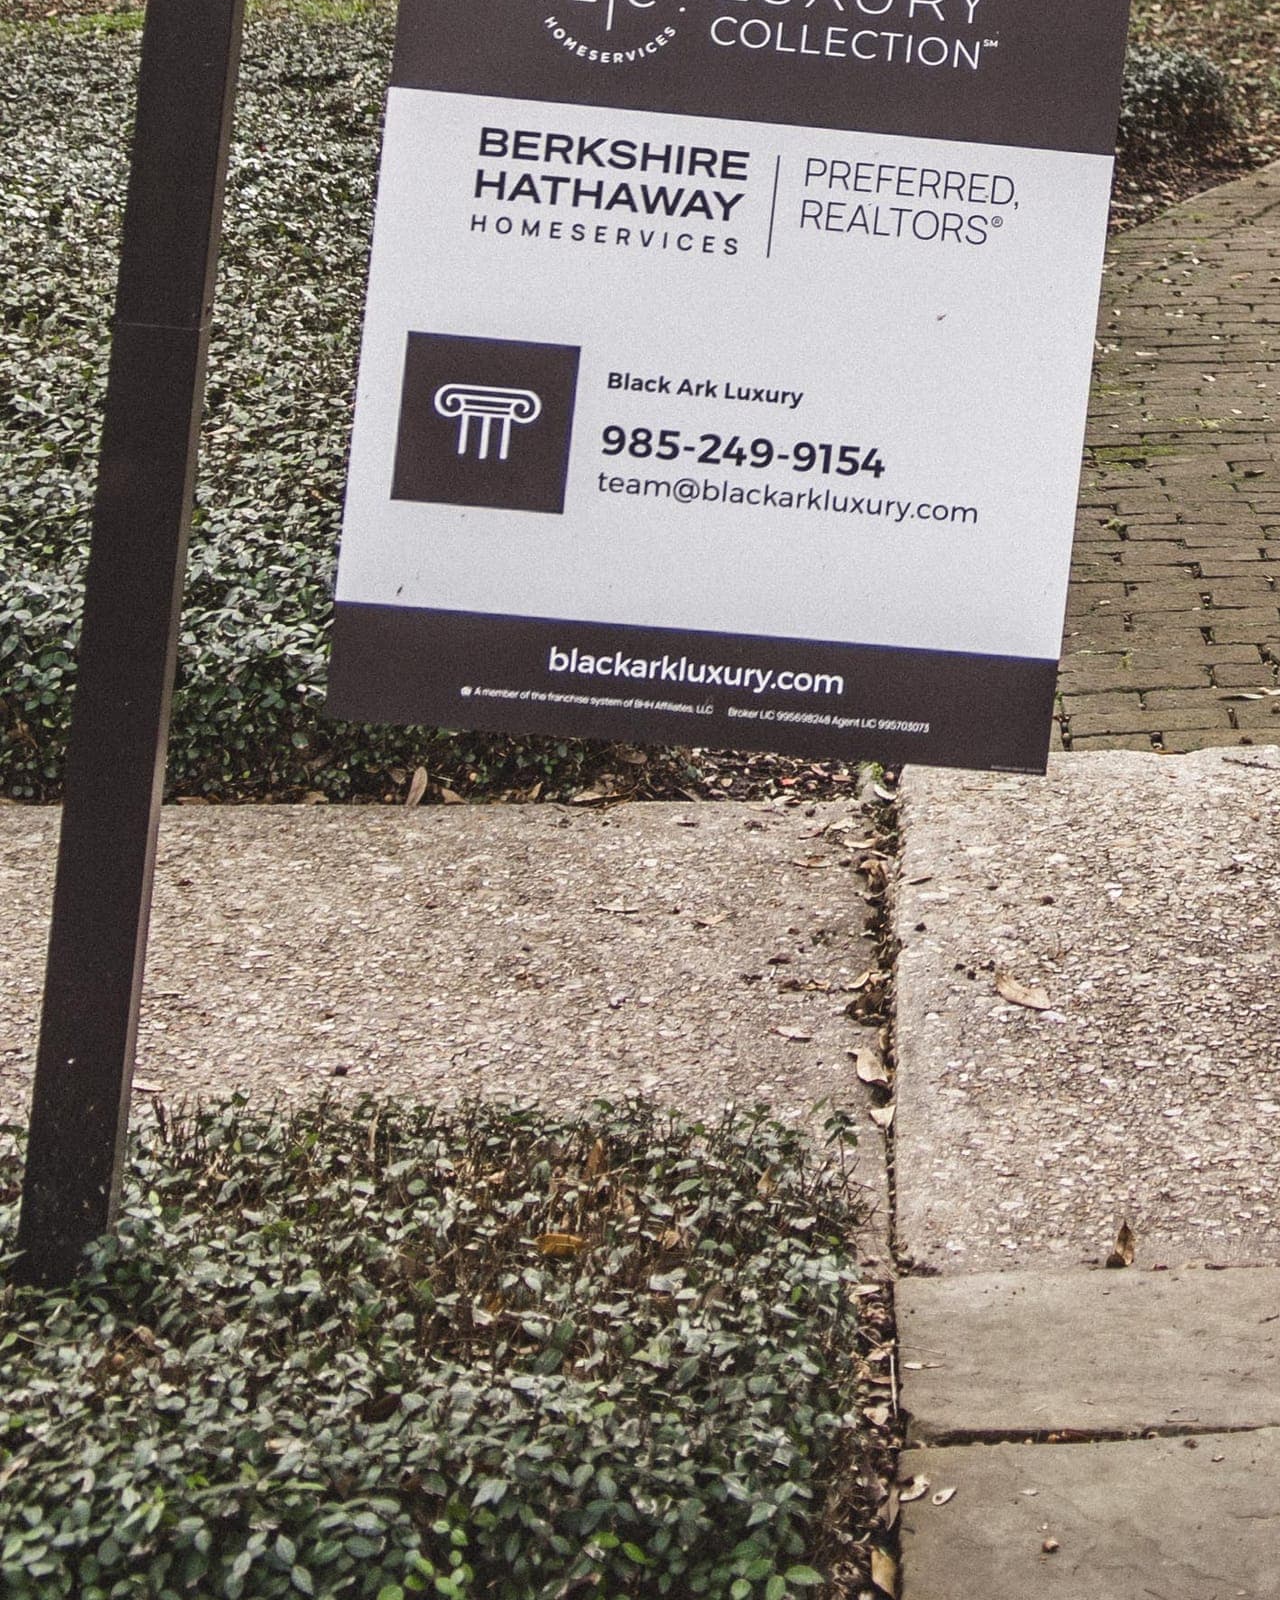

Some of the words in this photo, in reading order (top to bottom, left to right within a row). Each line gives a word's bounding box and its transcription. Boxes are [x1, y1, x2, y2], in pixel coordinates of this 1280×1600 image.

[544, 16, 677, 63] HOMESERVICES
[479, 127, 751, 181] BERKSHIRE
[474, 169, 745, 221] HATHAWAY
[804, 157, 1019, 210] PREFERRED,
[471, 214, 739, 255] HOMESERVICES
[607, 371, 671, 394] Black
[676, 378, 718, 398] Ark
[724, 382, 803, 409] Luxury
[601, 425, 885, 478] 985-249-9154
[598, 471, 978, 523] team@blackarkluxury.com
[549, 646, 844, 694] blackarkluxury.com
[474, 686, 482, 696] A
[482, 687, 519, 699] member
[519, 690, 531, 701] of
[531, 691, 547, 701] the
[547, 692, 589, 705] franchise
[590, 695, 623, 707] system
[623, 697, 633, 708] of
[728, 706, 759, 718] Broker
[831, 716, 860, 729] Agent
